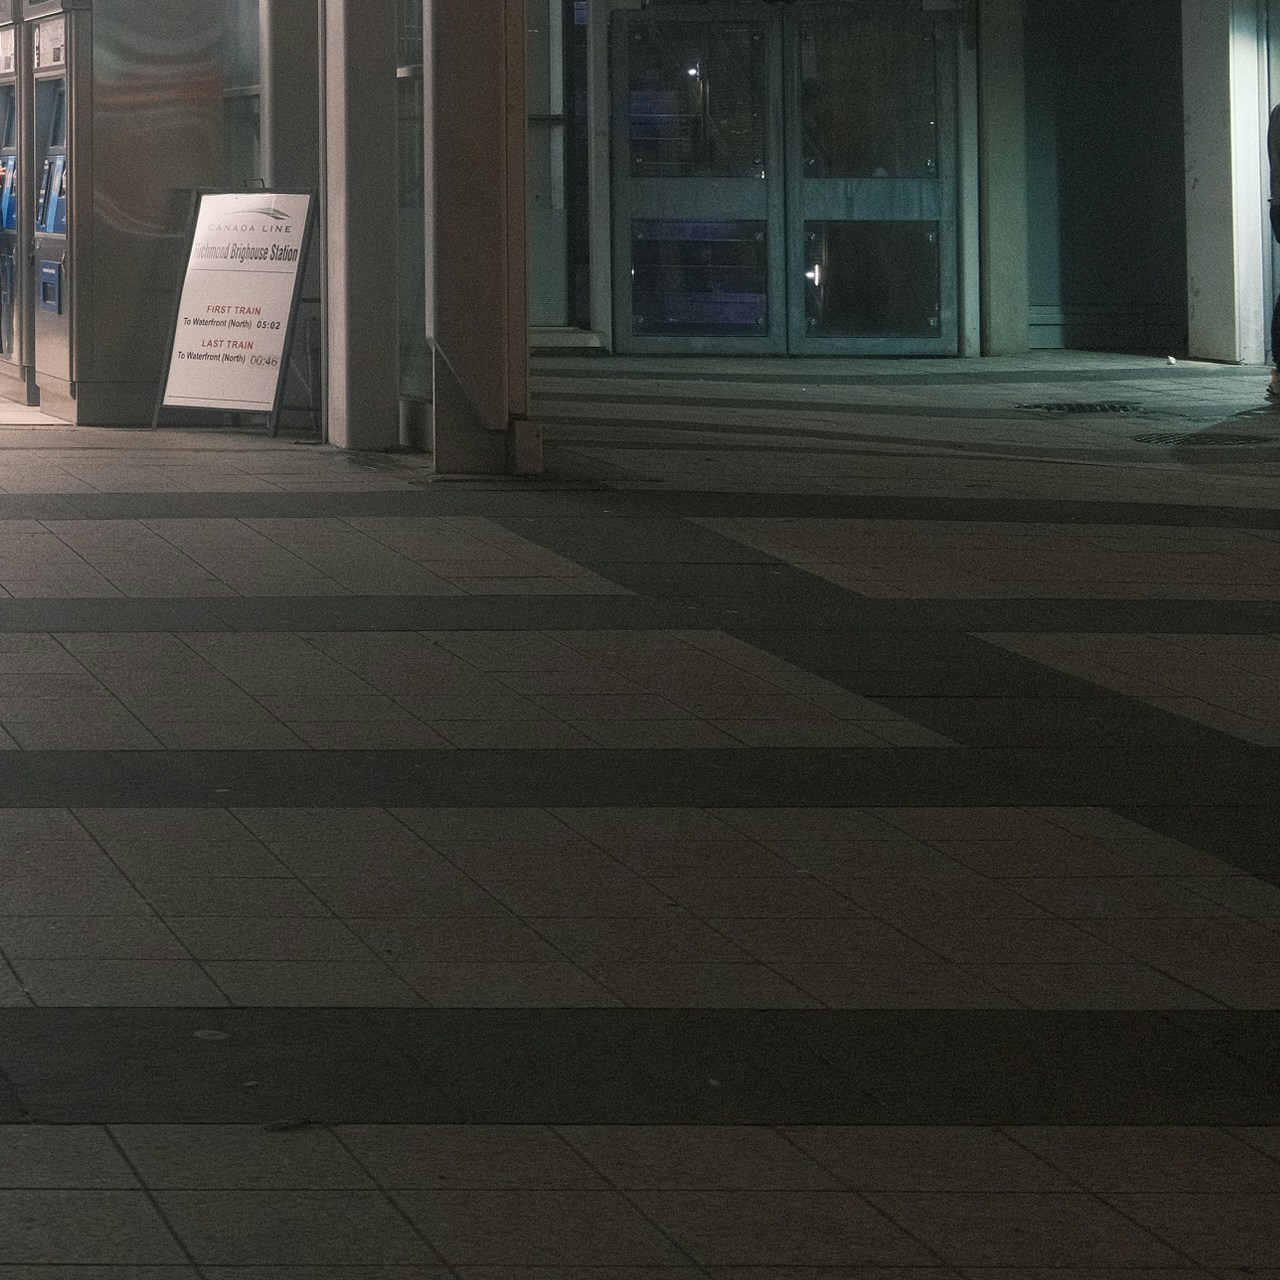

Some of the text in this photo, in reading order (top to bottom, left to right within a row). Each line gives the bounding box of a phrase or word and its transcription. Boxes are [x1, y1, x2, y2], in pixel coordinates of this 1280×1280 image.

[208, 224, 292, 233] CANADA LINE
[195, 242, 298, 263] Richmond Brighouse Station
[206, 305, 261, 315] FIRST TRAIN
[183, 317, 280, 330] To Waterfront (North) 05:02
[202, 339, 254, 349] LAST TRAIN
[178, 351, 278, 367] To Waterfront (North) 00:46
